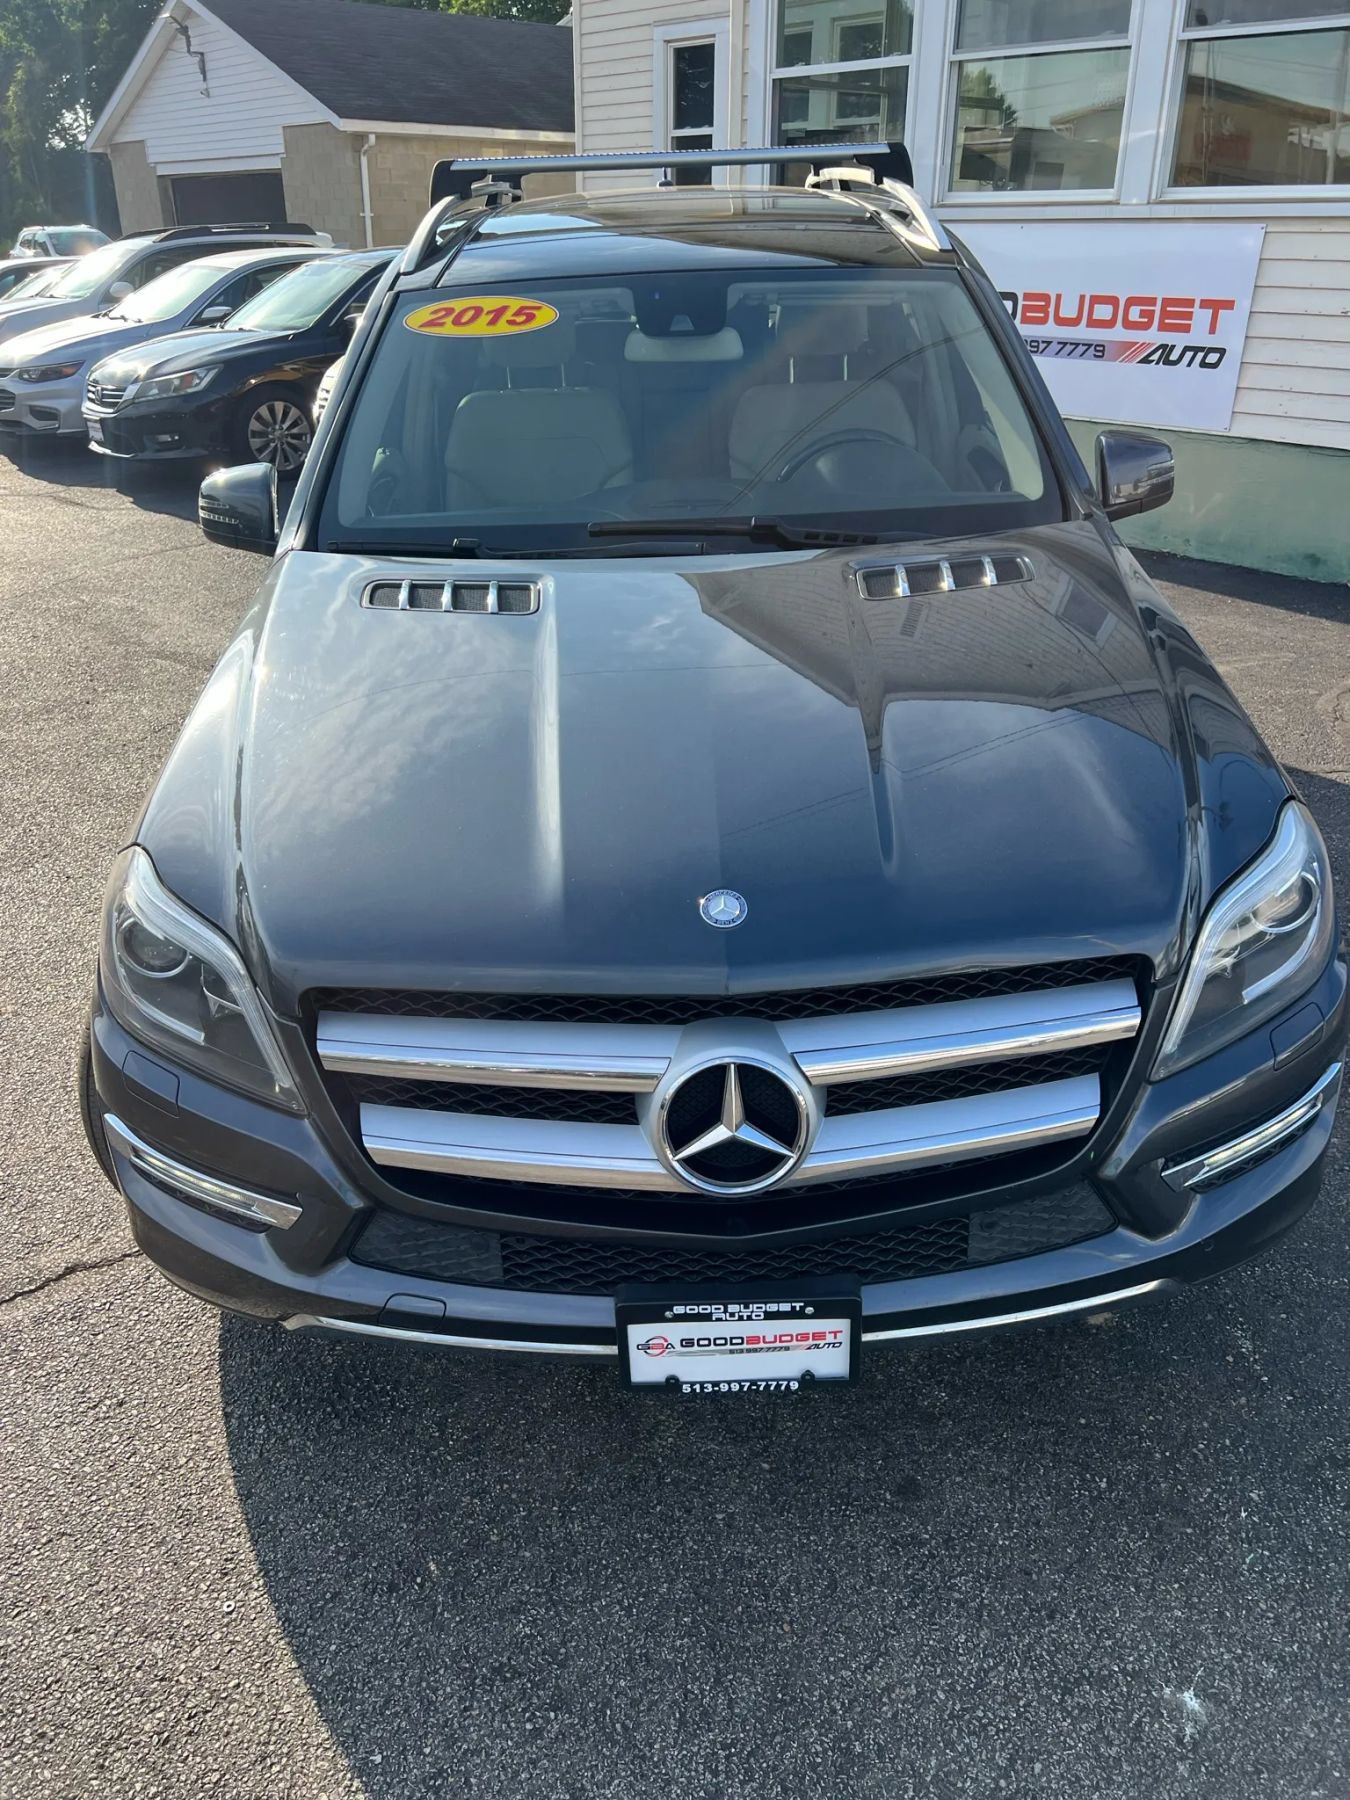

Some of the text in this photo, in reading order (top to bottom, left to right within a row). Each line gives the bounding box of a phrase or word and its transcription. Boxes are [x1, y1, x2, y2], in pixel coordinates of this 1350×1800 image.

[417, 305, 543, 328] 2015
[1024, 339, 1106, 358] 97 7779
[1137, 343, 1227, 369] AUTO
[673, 1302, 804, 1314] GOOD BUDGET
[712, 1312, 764, 1321] AUTO
[806, 1341, 842, 1350] AUTO
[682, 1381, 799, 1393] 513-997-7779
